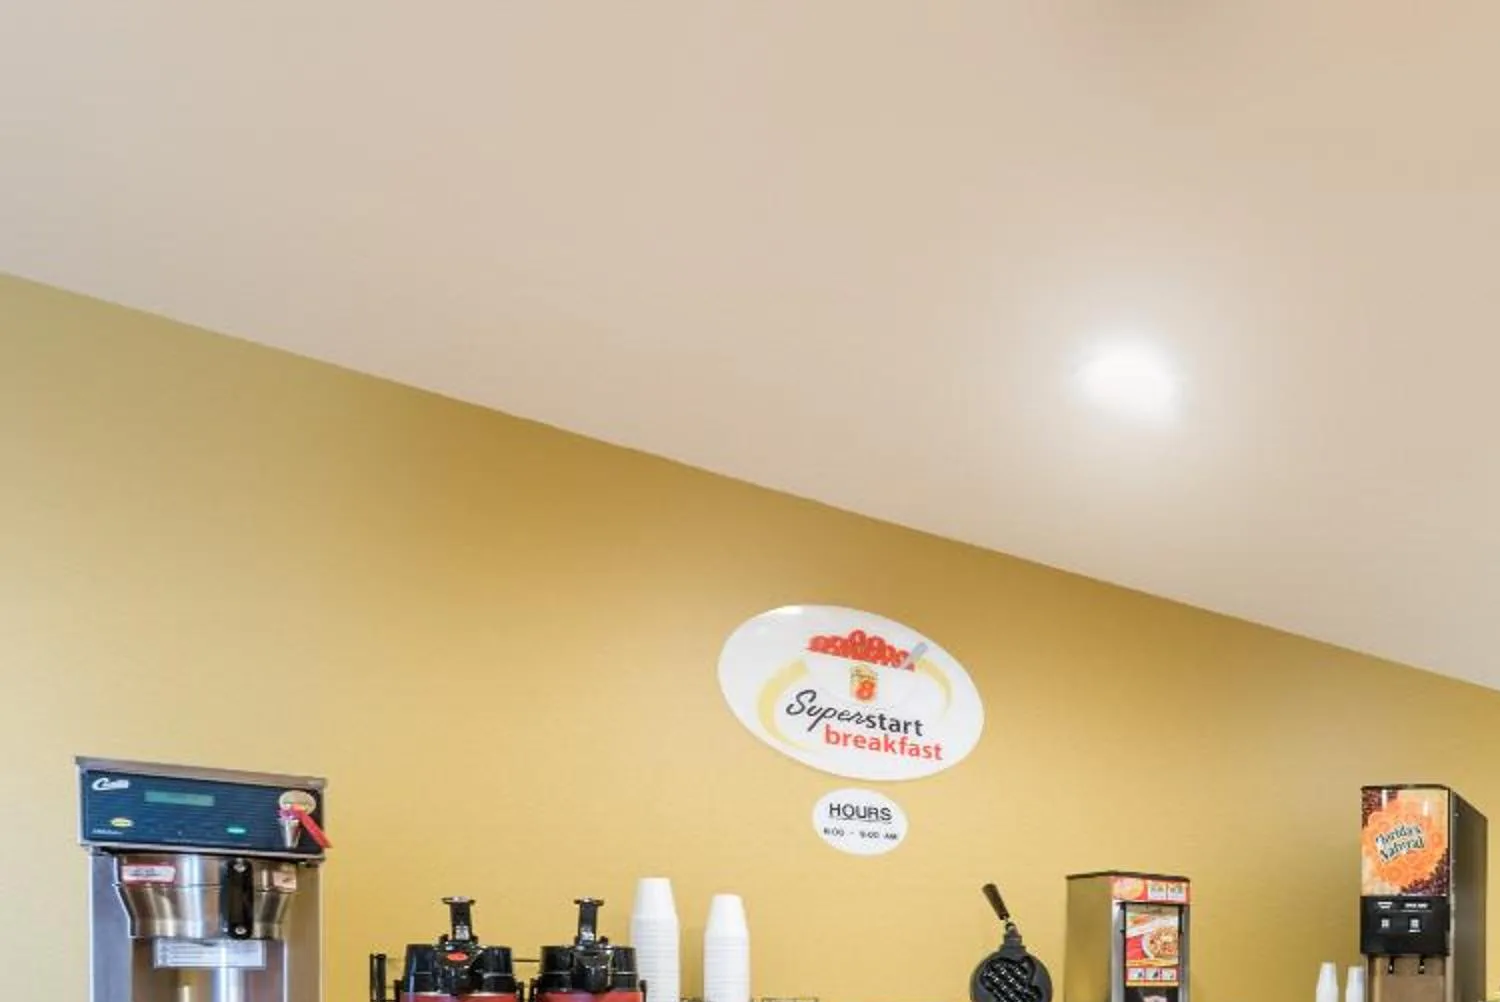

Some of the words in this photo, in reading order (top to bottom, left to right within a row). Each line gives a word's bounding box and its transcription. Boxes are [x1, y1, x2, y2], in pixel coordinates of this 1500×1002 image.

[786, 689, 924, 737] Superstart
[824, 724, 944, 761] breakfast
[828, 802, 893, 821] HOURS
